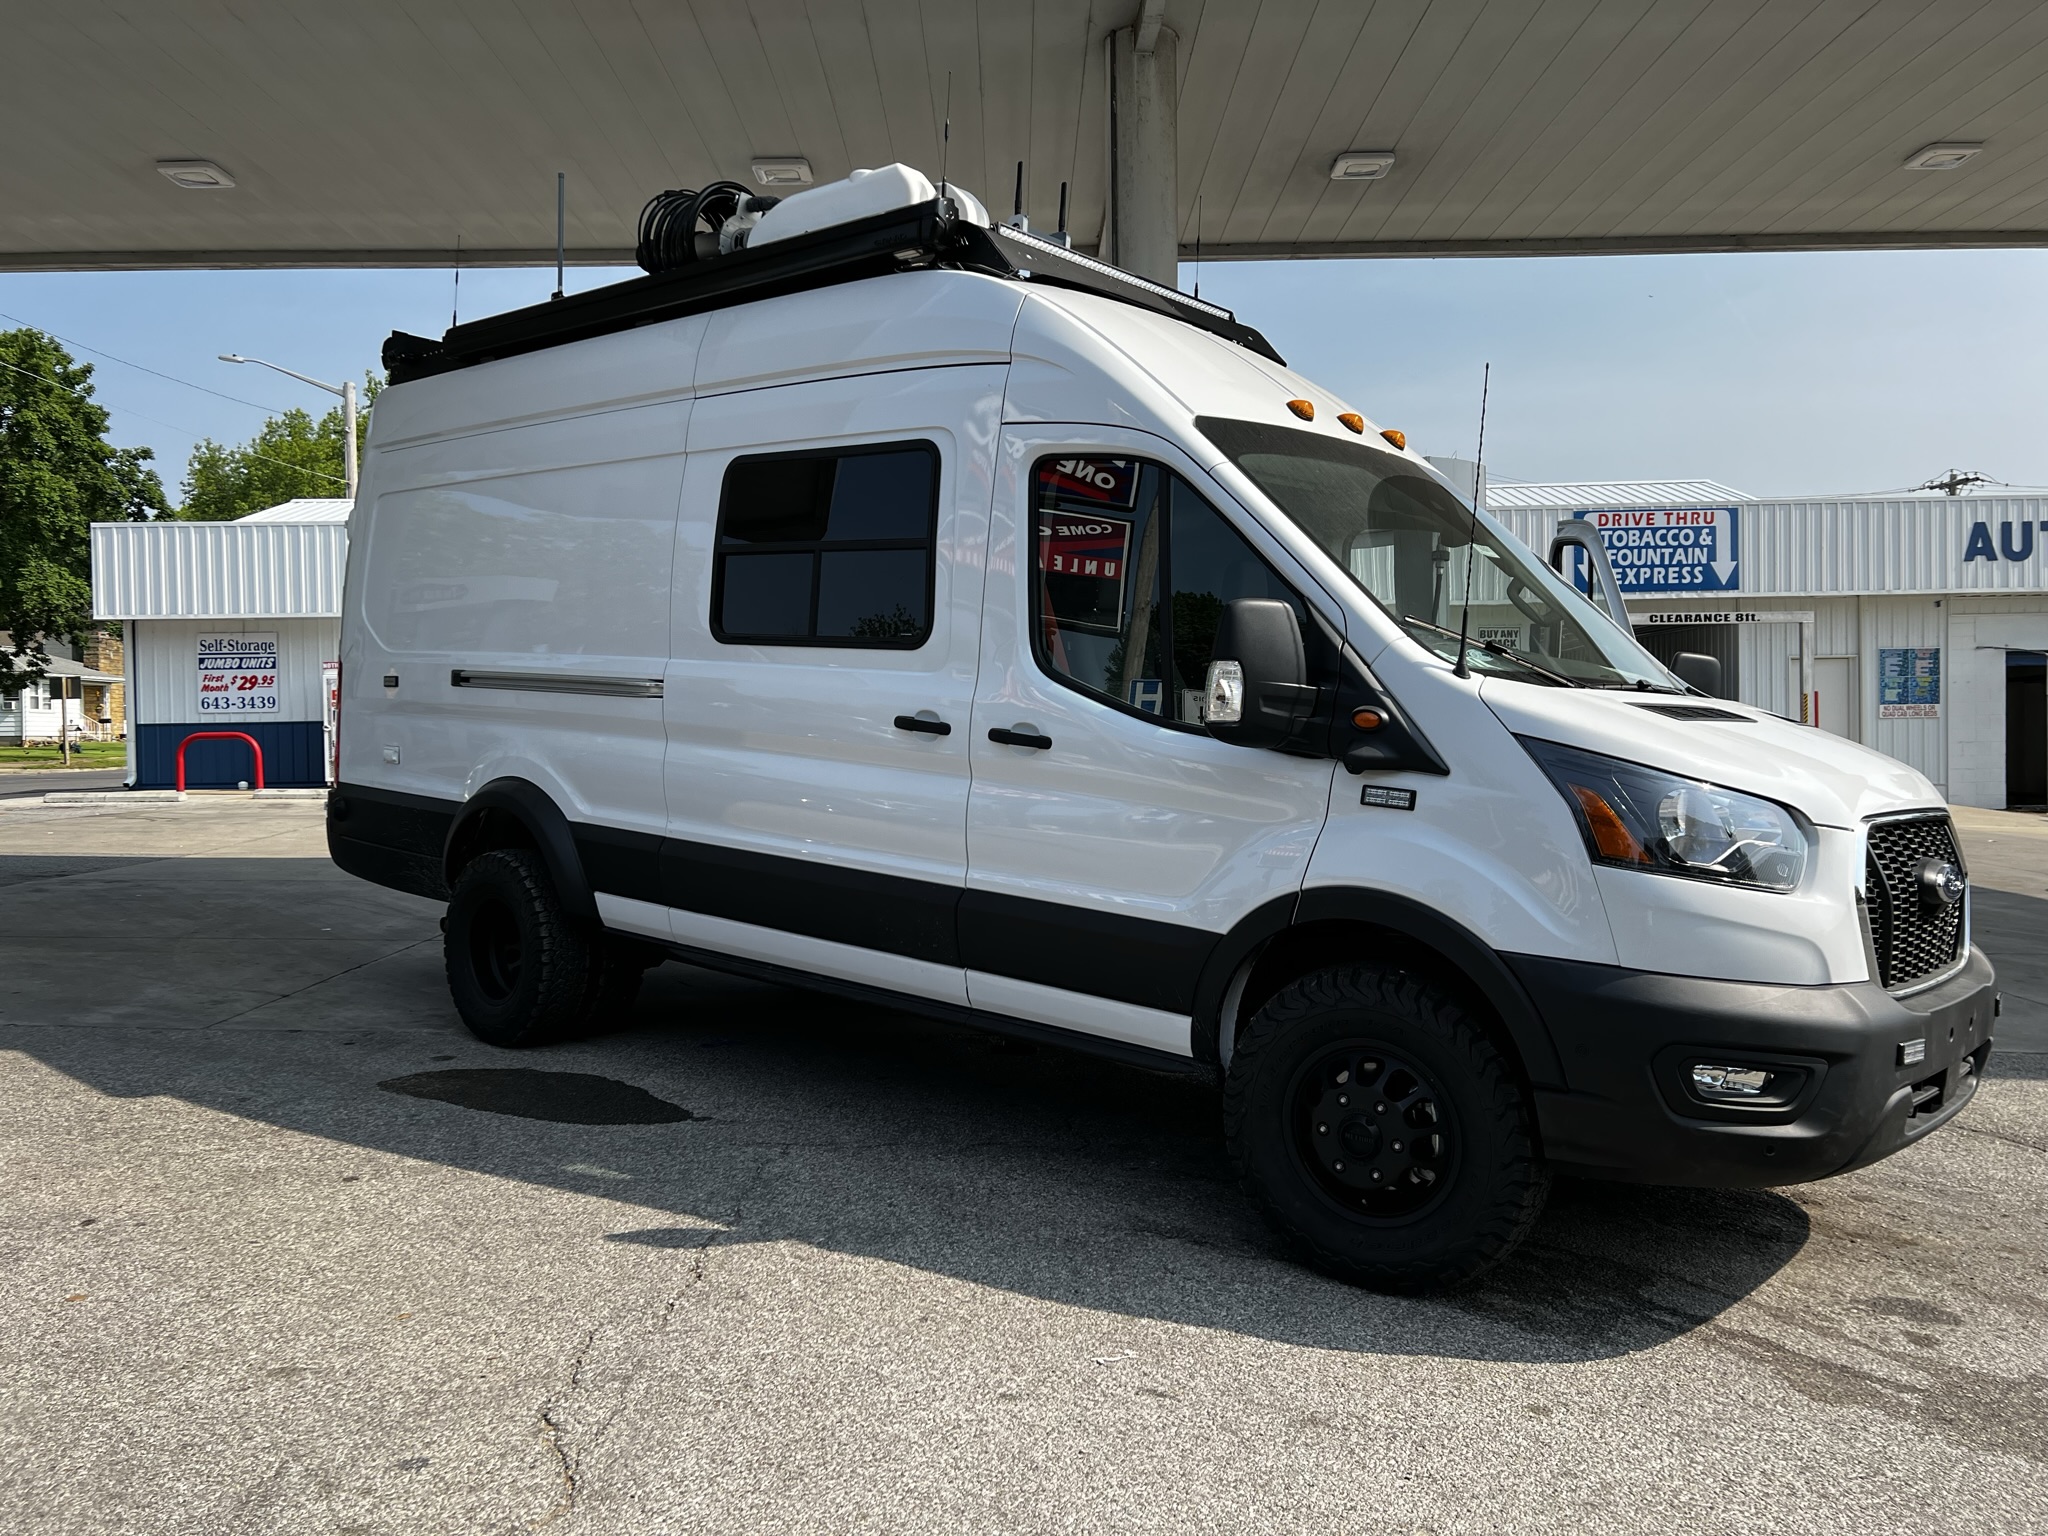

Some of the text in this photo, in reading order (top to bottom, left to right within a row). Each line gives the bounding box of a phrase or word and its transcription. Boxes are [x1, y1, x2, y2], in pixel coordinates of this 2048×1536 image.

[1598, 511, 1714, 527] DRIVE THRU
[1601, 528, 1713, 548] TOBACCO &
[1963, 521, 2048, 562] AU
[1607, 547, 1708, 567] FOUNTAIN
[1614, 566, 1704, 585] EXPRESS
[1649, 612, 1761, 624] CLEARANCE 8ft.
[1480, 630, 1518, 639] BUY ANY
[199, 638, 275, 655] Self-Storage
[200, 658, 274, 669] JUMBO UNITS
[203, 674, 224, 682] First
[201, 683, 229, 692] Month
[201, 696, 276, 710] 643-3439
